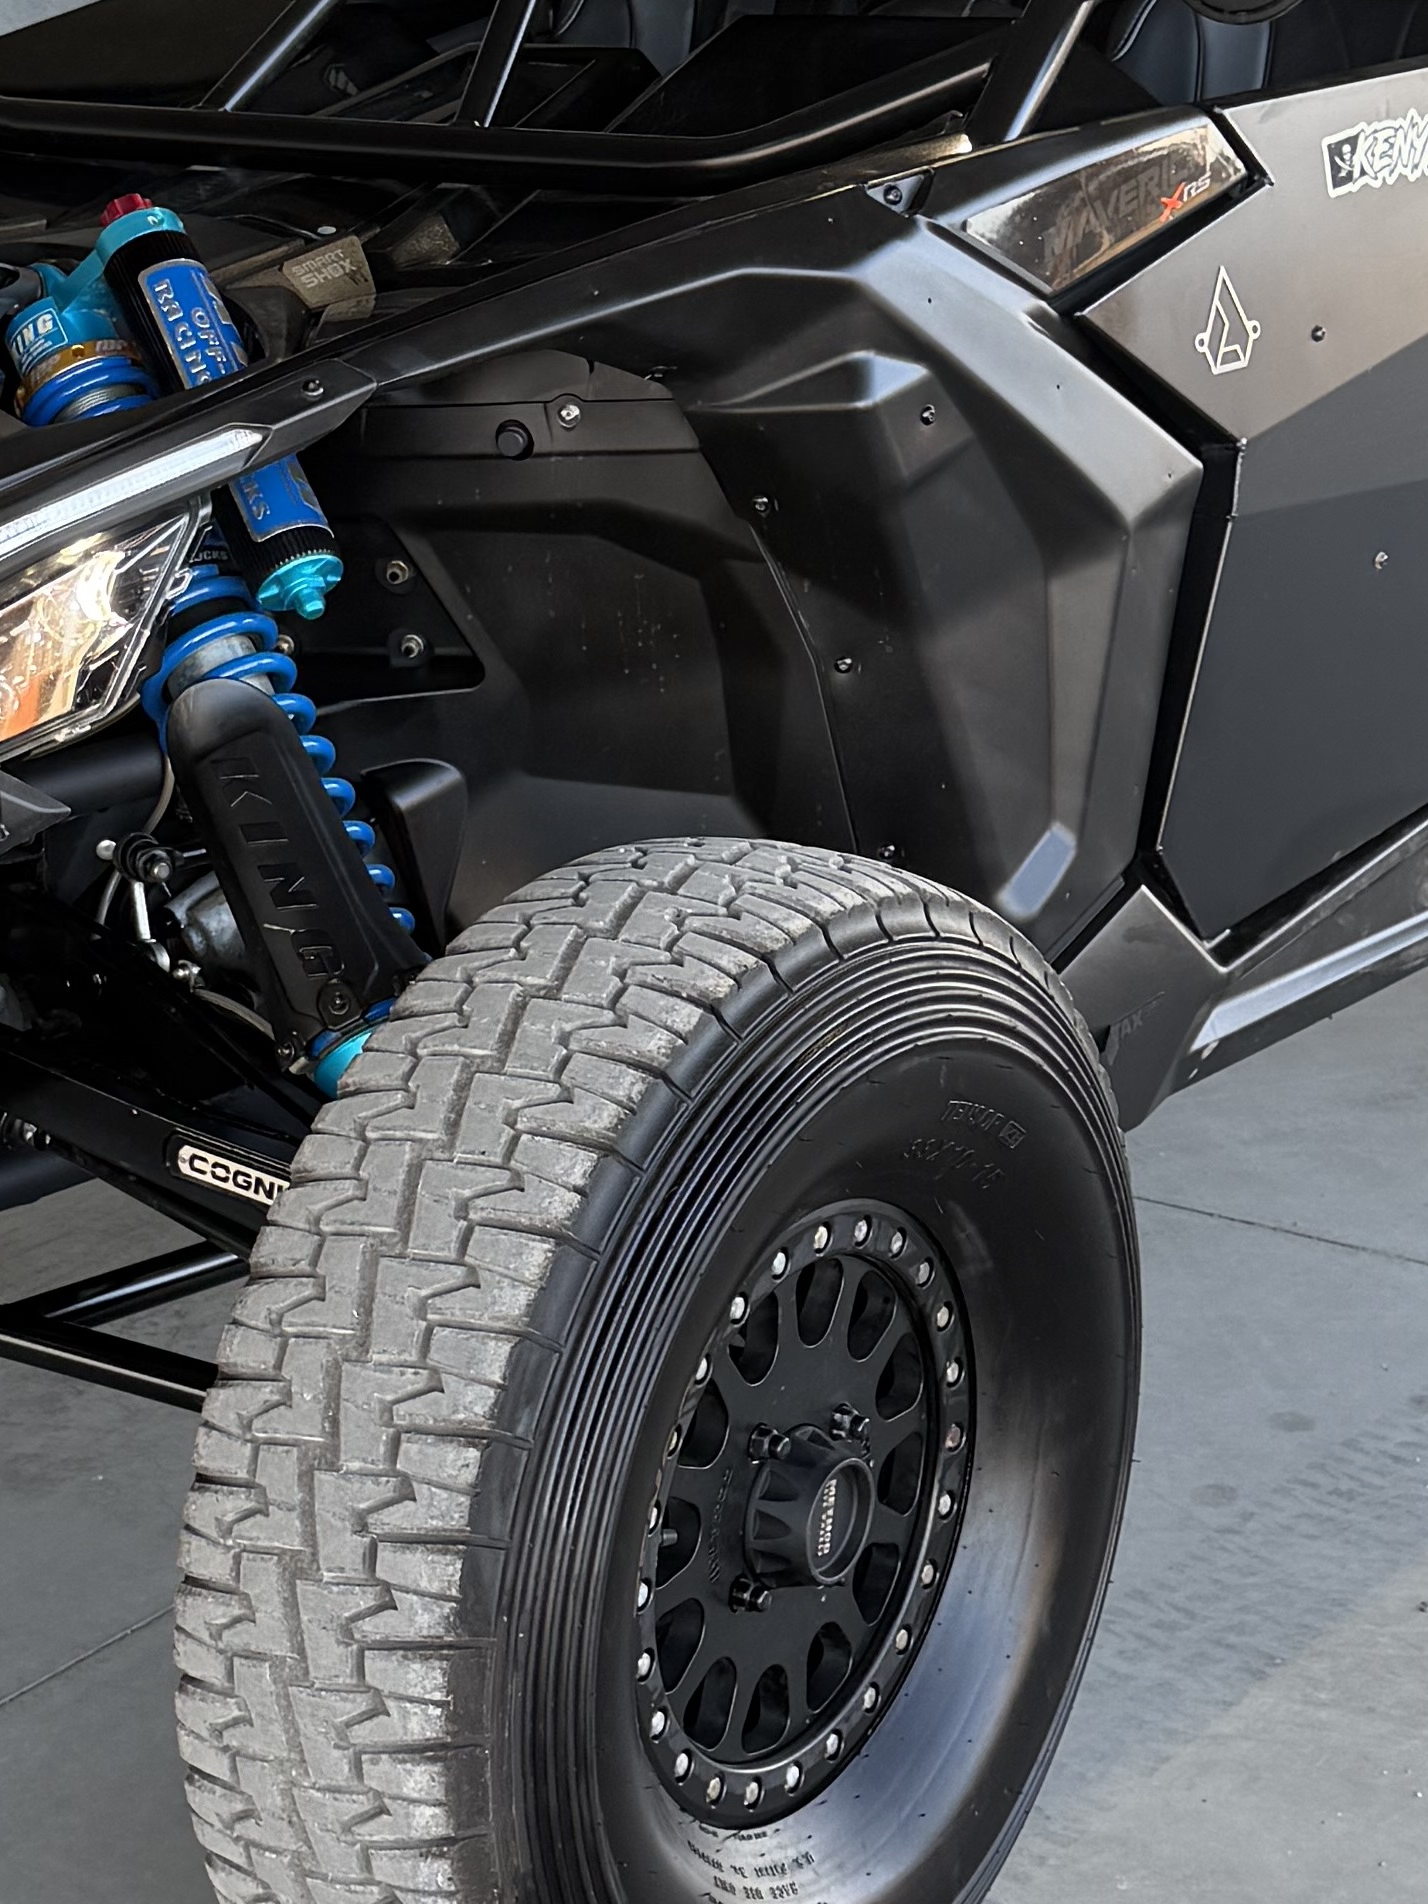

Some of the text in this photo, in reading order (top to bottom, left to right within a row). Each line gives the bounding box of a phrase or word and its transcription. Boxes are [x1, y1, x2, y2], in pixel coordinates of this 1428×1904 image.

[292, 249, 344, 276] SMART
[300, 258, 357, 288] SHOX
[215, 758, 345, 981] KING
